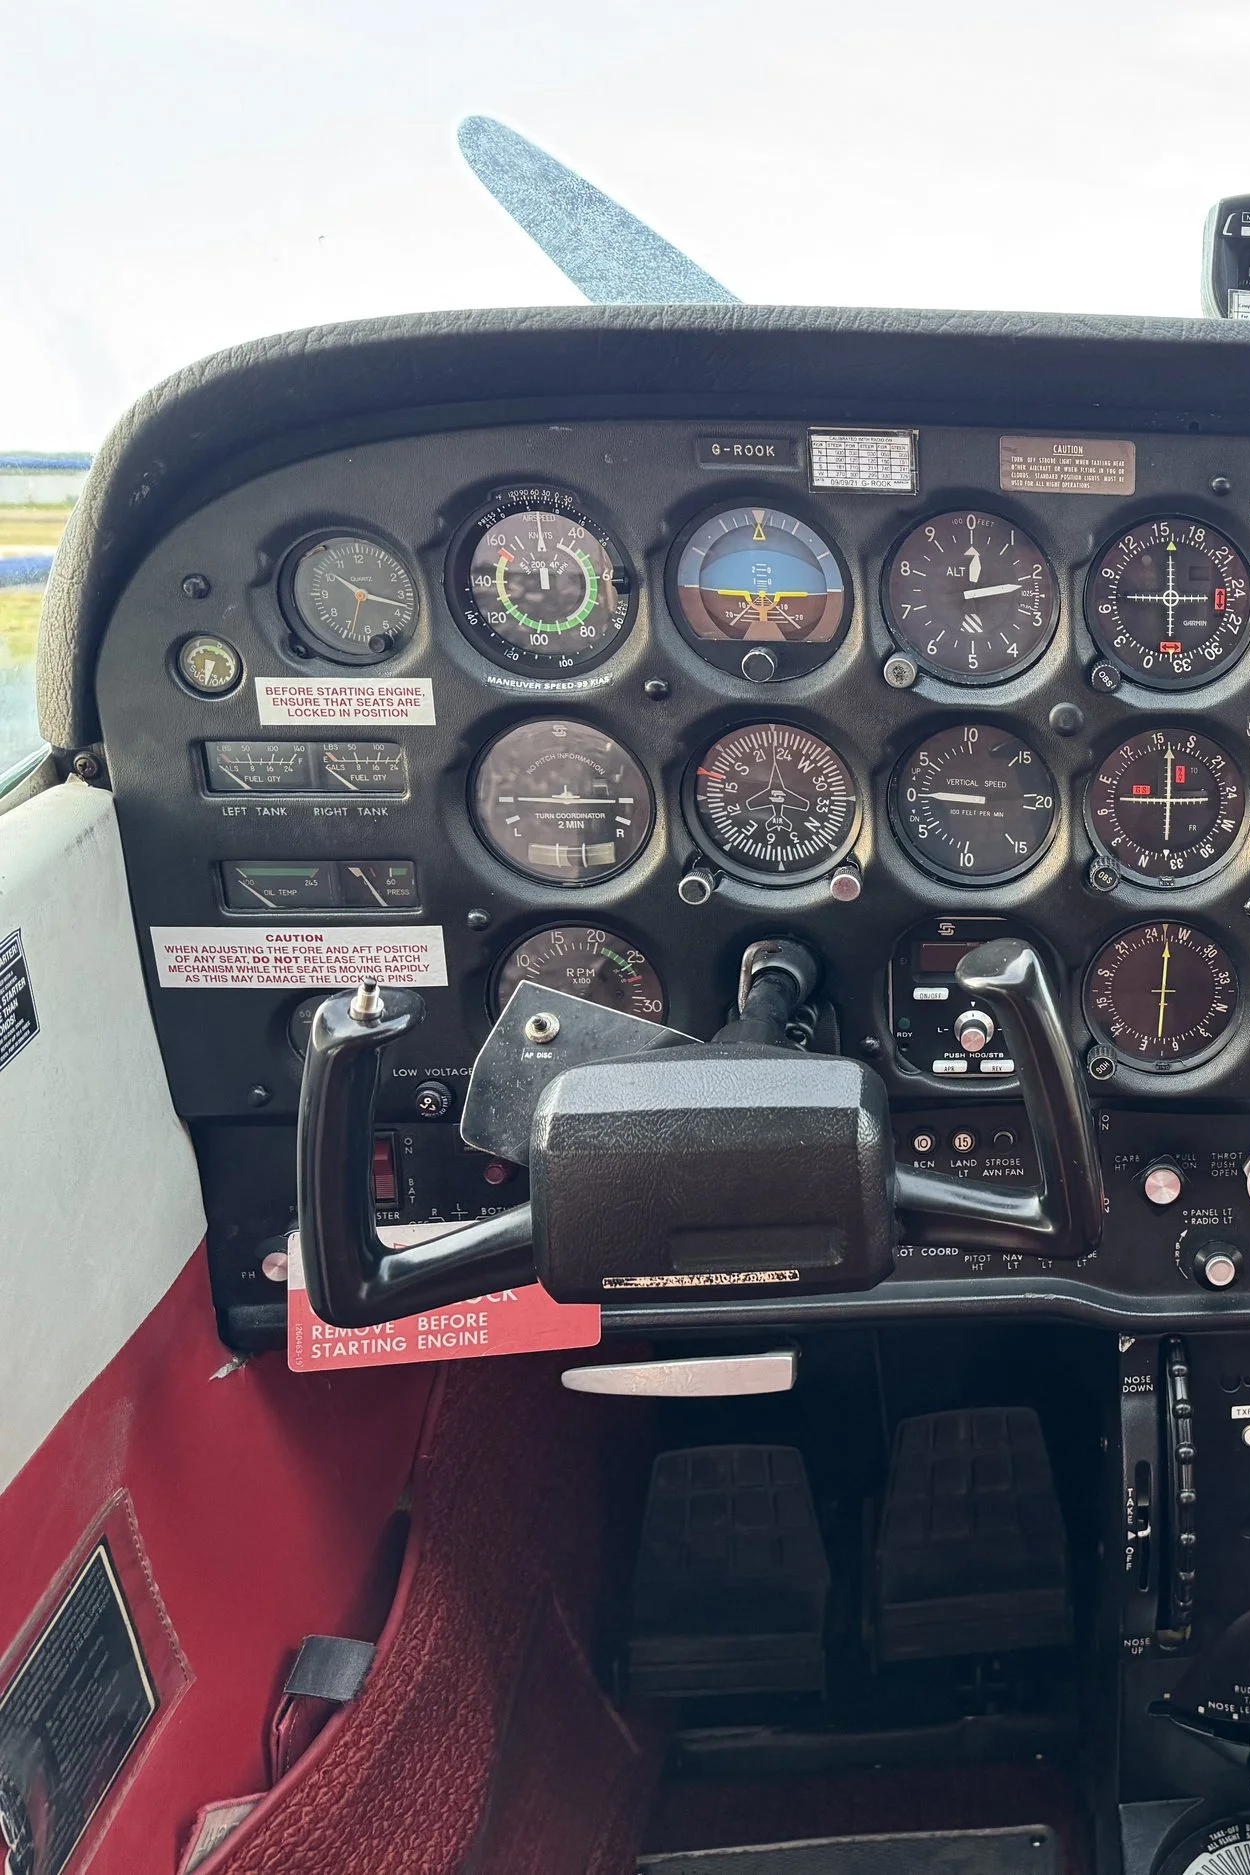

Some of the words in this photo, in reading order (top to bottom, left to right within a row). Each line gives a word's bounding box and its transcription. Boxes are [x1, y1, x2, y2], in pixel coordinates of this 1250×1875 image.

[711, 444, 775, 457] G-ROOK
[1053, 445, 1083, 454] CAUTION
[925, 527, 935, 542] 9
[900, 561, 910, 575] 8
[947, 567, 965, 577] ALT
[902, 605, 911, 619] 7
[488, 612, 506, 623] 120
[580, 626, 596, 638] 80
[530, 635, 548, 645] 100
[927, 640, 937, 654] 6
[1007, 643, 1018, 657] 4
[969, 654, 978, 668] 5
[266, 687, 313, 696] BEFORE
[317, 688, 374, 696] STARTING
[378, 688, 425, 697] ENGINE,
[273, 698, 320, 706] ENSURE
[324, 698, 353, 706] THAT
[358, 698, 394, 707] SEATS
[397, 699, 420, 707] ARE
[288, 708, 336, 717] LOCKED
[339, 709, 351, 717] IN
[354, 709, 408, 717] POSITION
[1036, 796, 1052, 808] 20
[223, 807, 247, 816] LEFT
[257, 807, 287, 815] TANK
[314, 808, 348, 816] RIGHT
[358, 807, 389, 816] TANK
[266, 934, 323, 942] CAUTION
[587, 930, 606, 942] 20
[165, 946, 199, 954] WHEN
[201, 946, 264, 954] ADJUSTING
[267, 946, 290, 954] THE
[292, 946, 323, 954] FORE
[326, 946, 349, 954] AND
[352, 946, 372, 954] AFT
[376, 945, 428, 954] POSITION
[219, 955, 250, 965] SEAT,
[253, 956, 270, 964] DO
[274, 956, 300, 964] NOT
[304, 955, 356, 964] RELEASE
[359, 955, 382, 963] THE
[384, 955, 420, 963] LATCH
[236, 965, 272, 973] WHILE
[274, 965, 295, 973] THE
[297, 965, 325, 973] SEAT
[327, 965, 336, 973] IS
[338, 965, 383, 973] MOVING
[385, 964, 429, 973] RAPIDLY
[567, 968, 595, 976] RPM
[202, 975, 228, 983] THIS
[231, 974, 254, 983] MAY
[257, 975, 305, 983] DAMAGE
[308, 975, 331, 983] THE
[388, 974, 416, 982] PINS.
[643, 1000, 662, 1012] 30
[1115, 1155, 1140, 1163] CARB
[1211, 1152, 1242, 1160] THROT
[986, 1158, 1020, 1166] STROBE
[1191, 1217, 1219, 1225] RADIO
[921, 1248, 959, 1256] COORD
[418, 1312, 488, 1331] BEFORE
[311, 1337, 407, 1359] STARTING
[418, 1330, 488, 1349] ENGINE
[1124, 1376, 1151, 1384] NOSE
[1122, 1384, 1154, 1392] DOWN
[1208, 1701, 1235, 1712] NOSE
